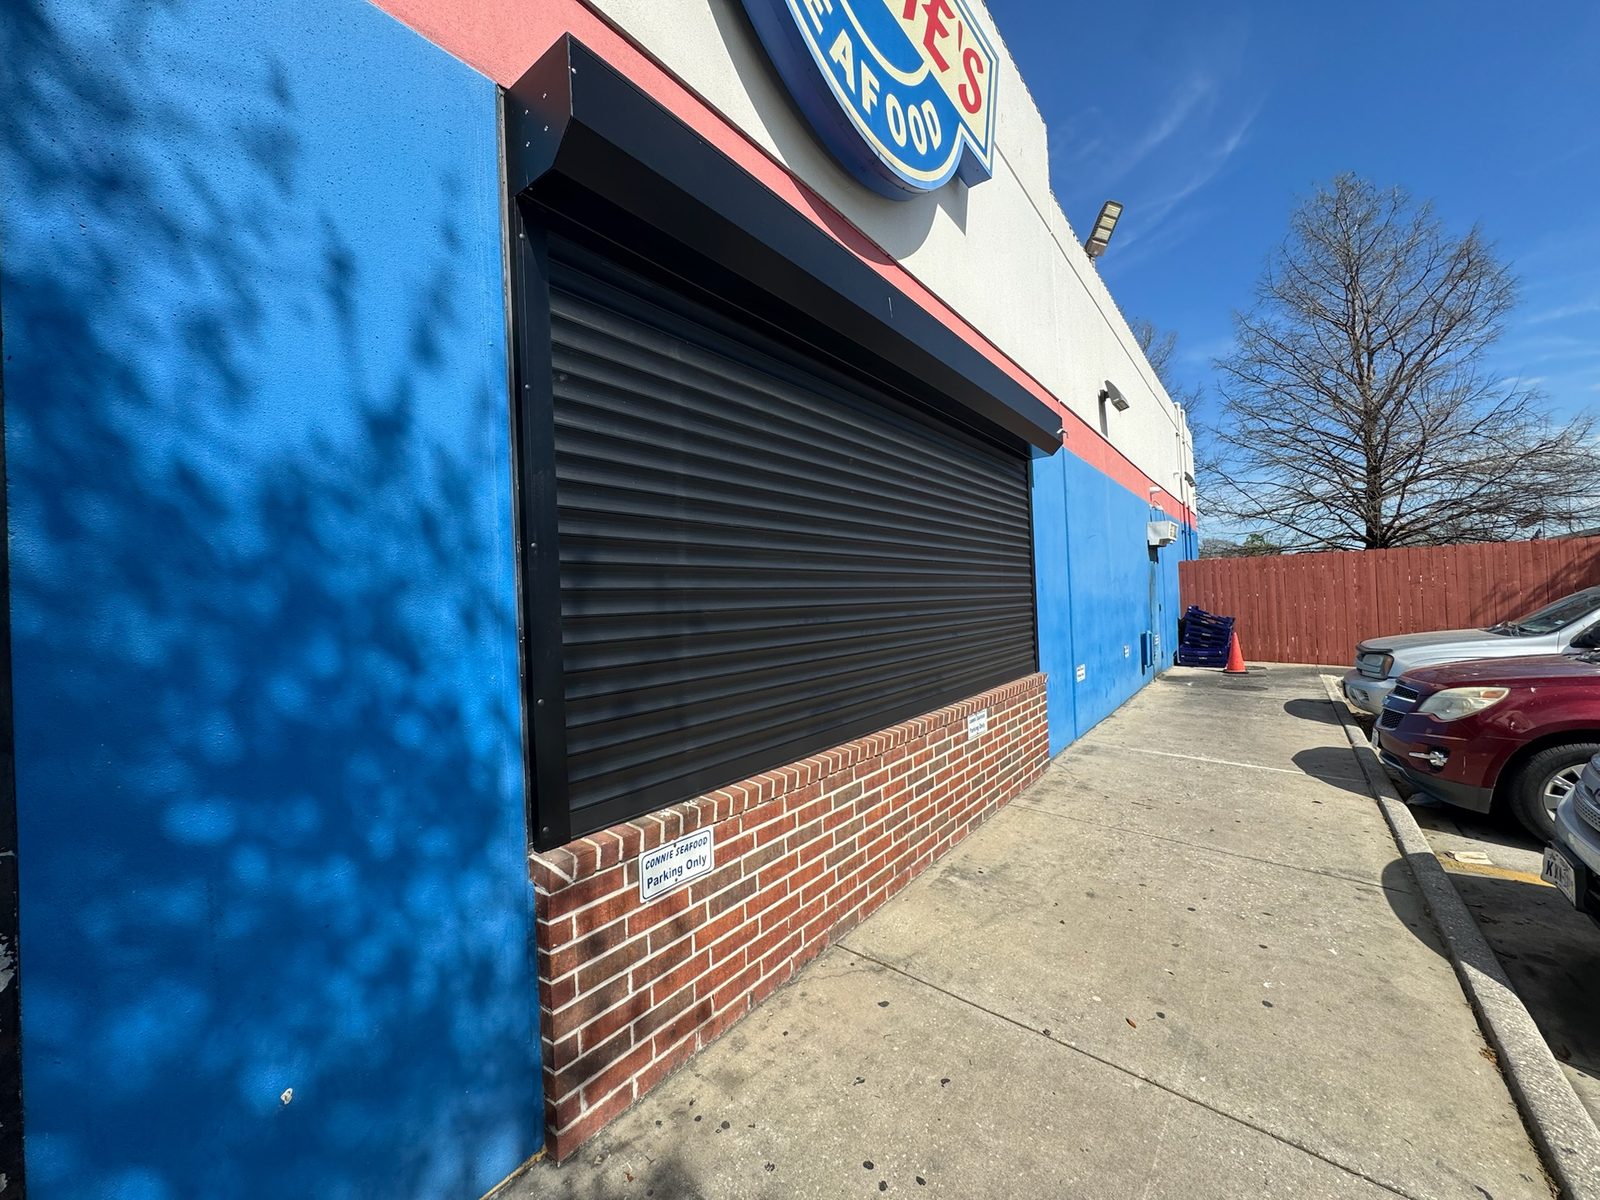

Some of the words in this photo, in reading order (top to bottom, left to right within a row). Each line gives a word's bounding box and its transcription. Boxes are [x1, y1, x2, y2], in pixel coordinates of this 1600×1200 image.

[645, 849, 674, 870] CONNIE
[675, 836, 708, 857] SEAFOOD
[646, 865, 683, 889] Parking
[686, 854, 707, 870] Only
